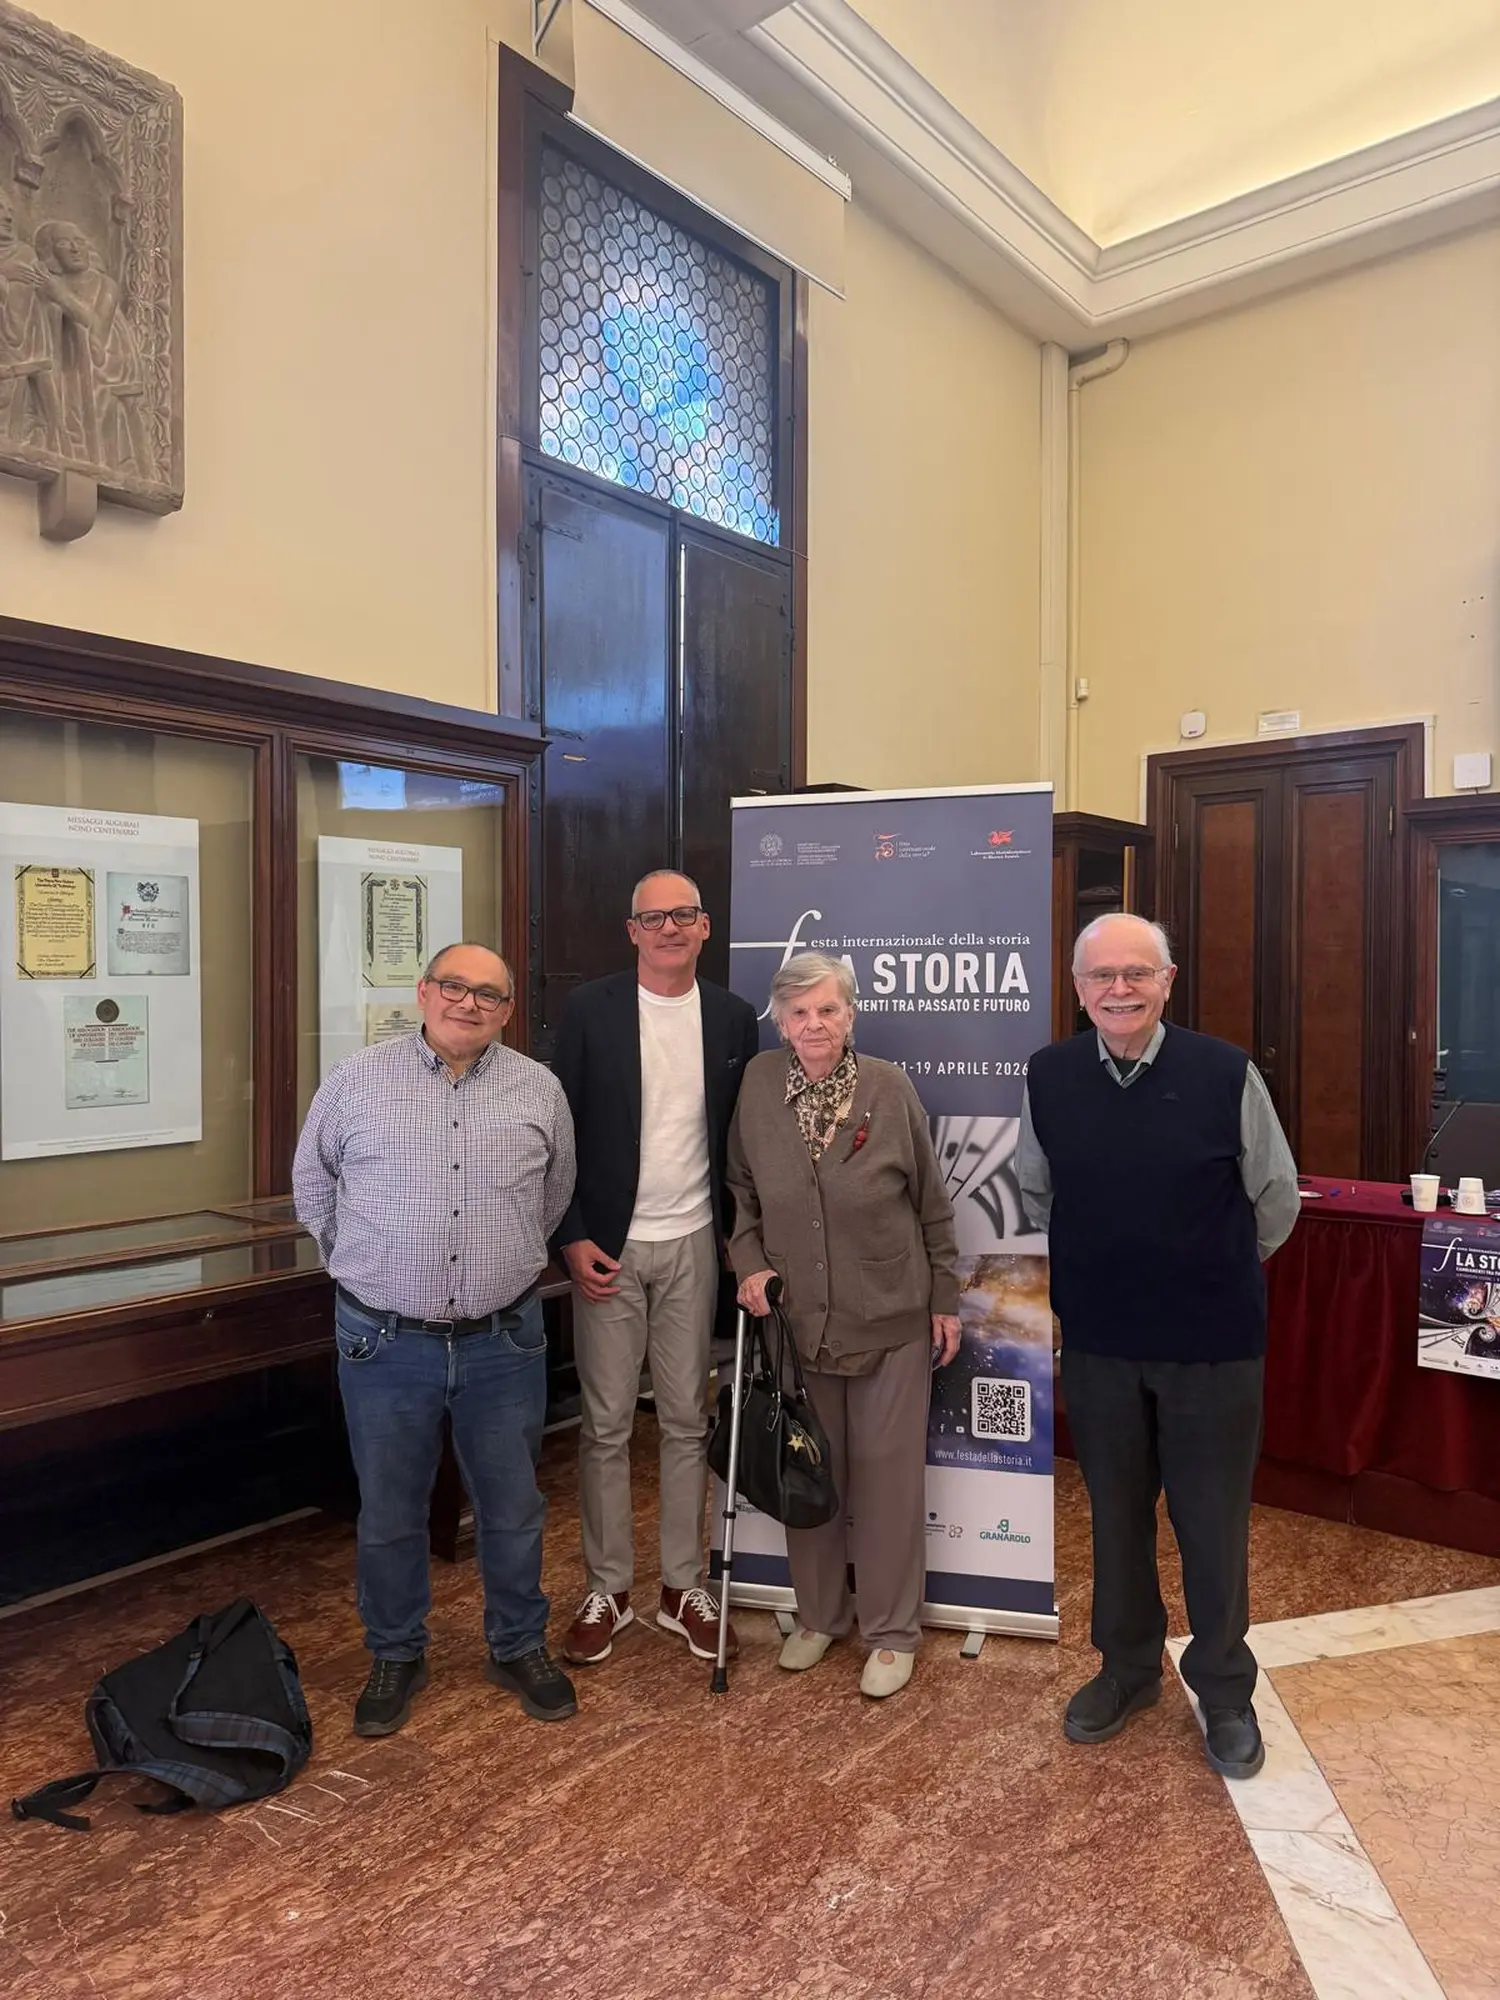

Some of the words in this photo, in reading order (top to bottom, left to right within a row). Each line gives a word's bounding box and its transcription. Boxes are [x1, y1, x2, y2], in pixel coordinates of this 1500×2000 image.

[843, 934, 945, 947] internazionale
[949, 933, 984, 946] della
[988, 933, 1031, 946] storia
[873, 952, 1030, 994] STORIA
[855, 999, 889, 1013] MENTI
[893, 999, 915, 1012] TRA
[918, 999, 970, 1012] PASSATO
[974, 999, 980, 1012] E
[983, 998, 1030, 1012] FUTURO
[937, 1061, 989, 1075] APRILE
[995, 1061, 1028, 1076] 2026
[1456, 1252, 1475, 1268] LA
[935, 1449, 1032, 1467] www.festadellastoria.it
[979, 1530, 1031, 1544] GRANAROLO
